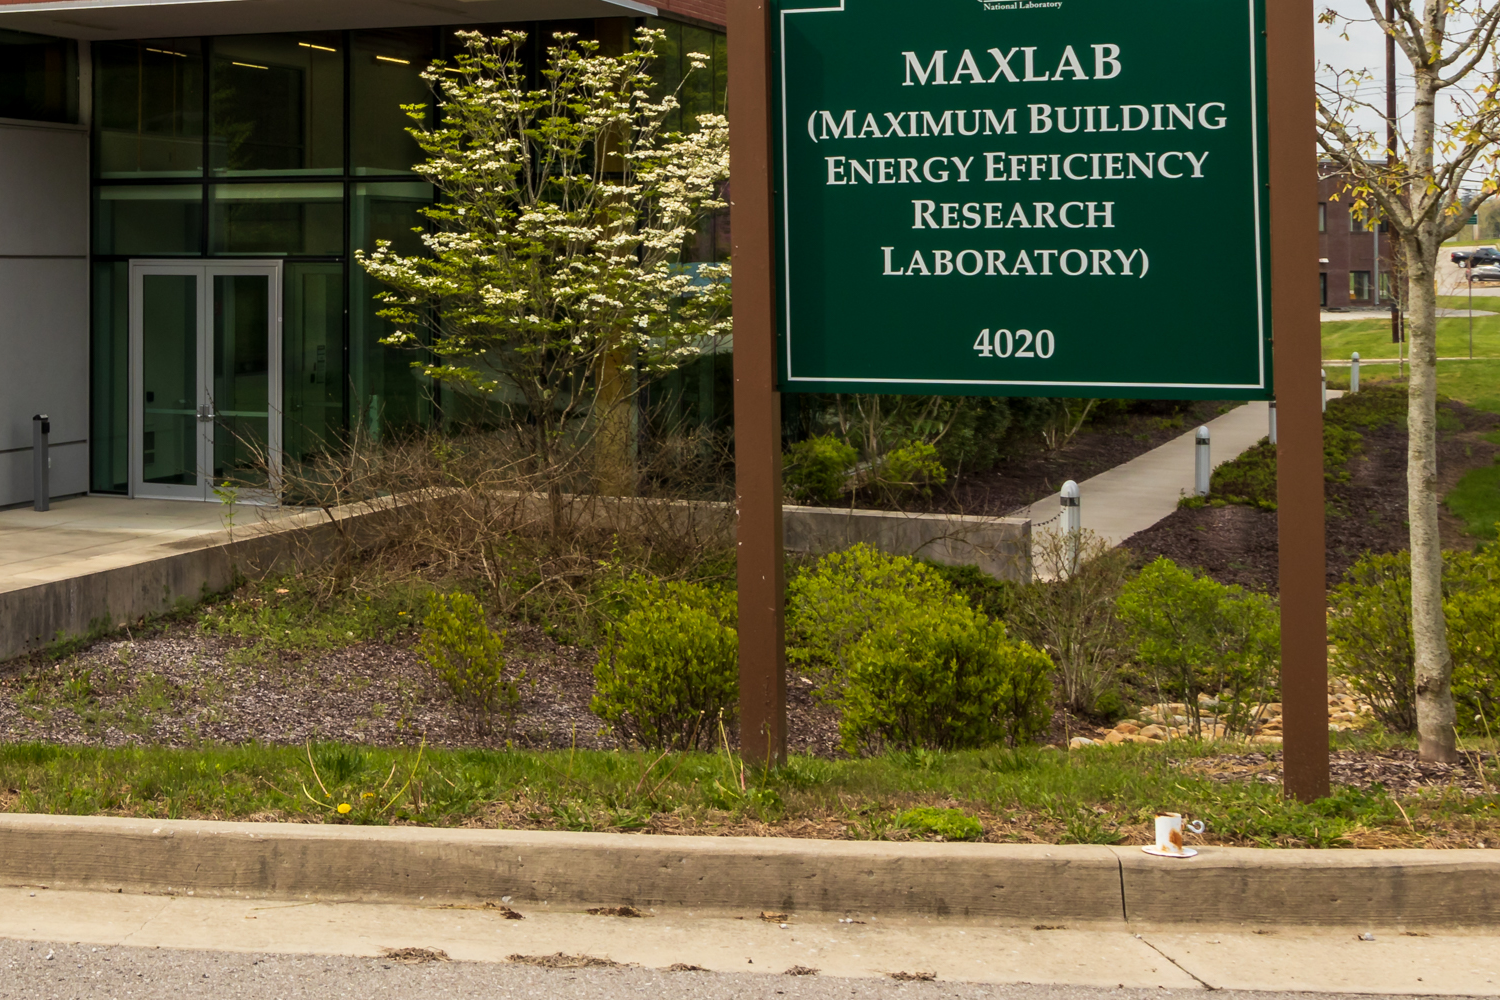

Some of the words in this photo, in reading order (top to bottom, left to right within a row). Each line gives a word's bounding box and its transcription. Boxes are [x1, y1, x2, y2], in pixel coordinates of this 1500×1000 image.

[983, 1, 1018, 11] National
[1019, 0, 1063, 10] Laboratory
[901, 43, 1122, 86] MAXLAB
[807, 108, 1018, 144] (MAXIMUM
[1026, 101, 1228, 134] BUILDING
[824, 155, 975, 186] ENERGY
[982, 151, 1210, 182] EFFICIENCY
[910, 199, 1115, 229] RESEARCH
[880, 246, 1150, 279] LABORATORY)
[972, 328, 1055, 359] 4020
